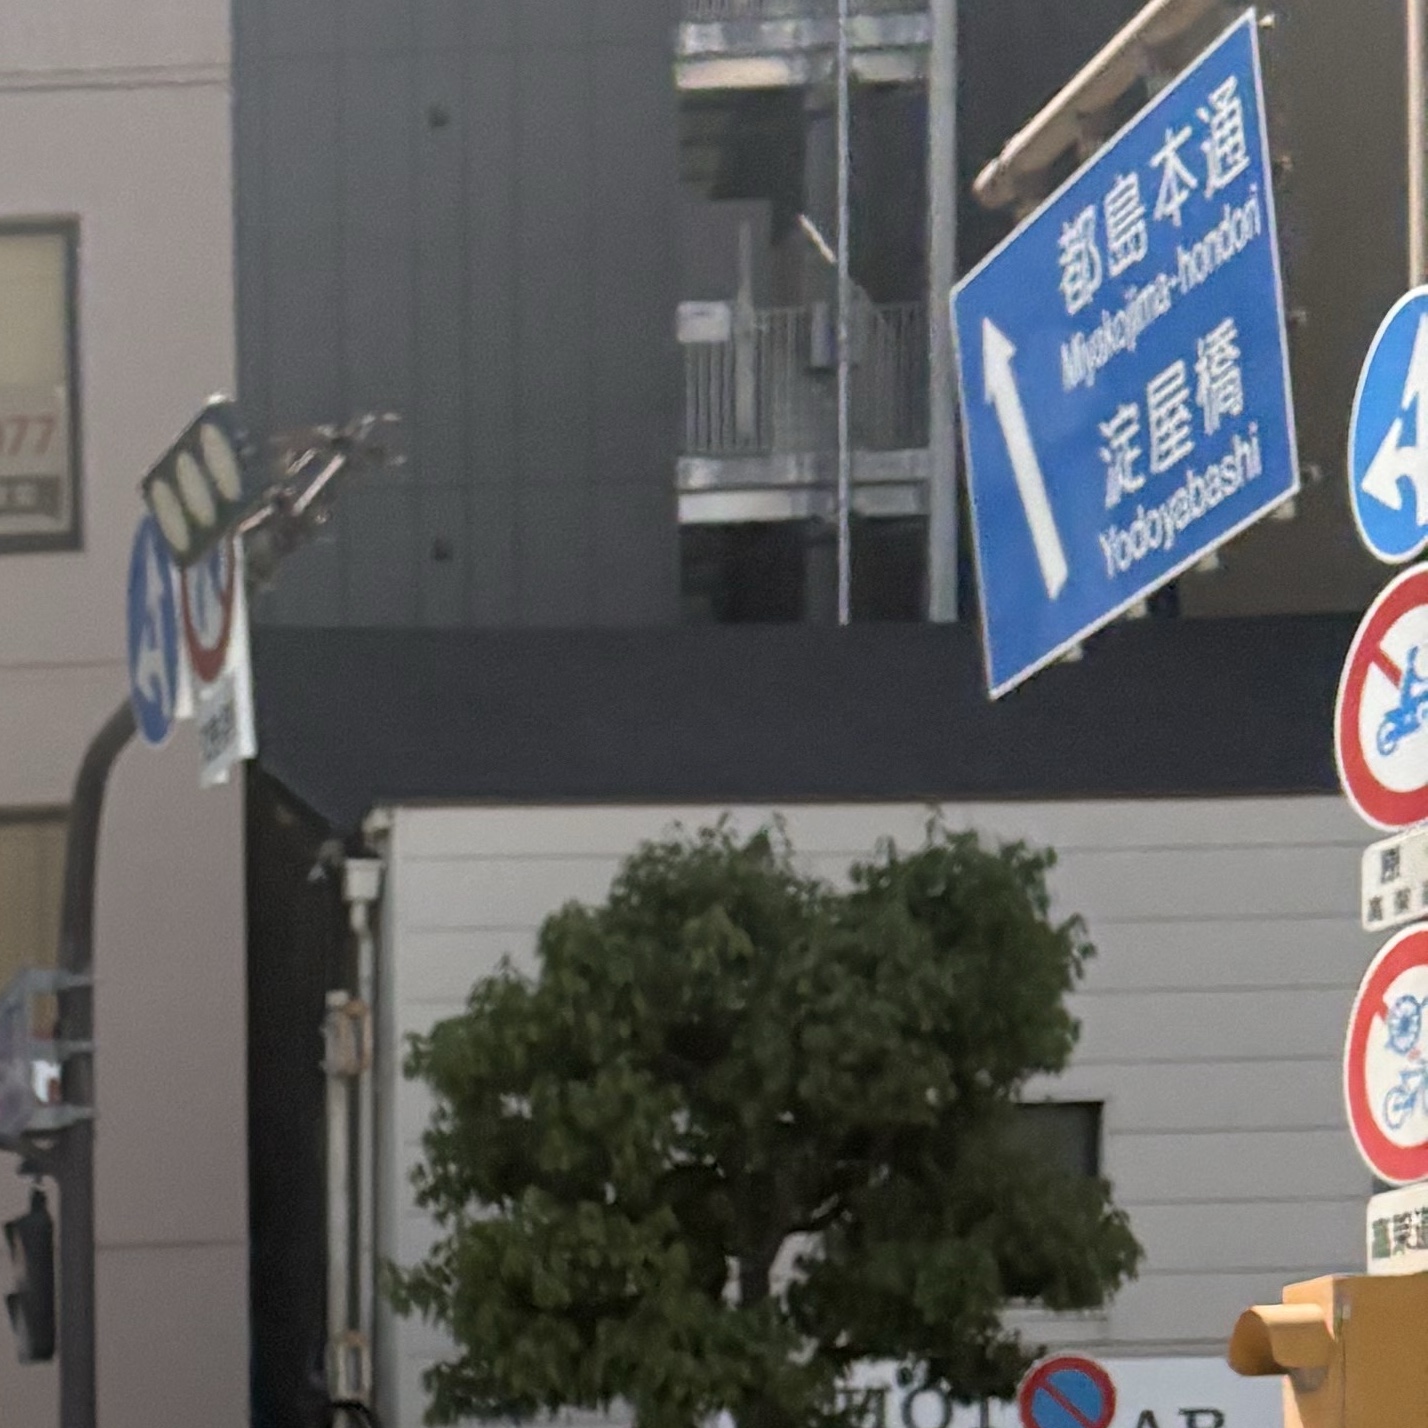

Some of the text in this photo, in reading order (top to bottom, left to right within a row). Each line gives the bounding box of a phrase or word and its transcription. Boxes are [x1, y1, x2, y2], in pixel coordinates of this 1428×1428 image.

[1057, 74, 1250, 316] 都島本通
[1059, 185, 1262, 391] Miyakojima-hondori
[1099, 317, 1244, 509] 淀屋橋
[1099, 421, 1263, 579] Yodoyabashi
